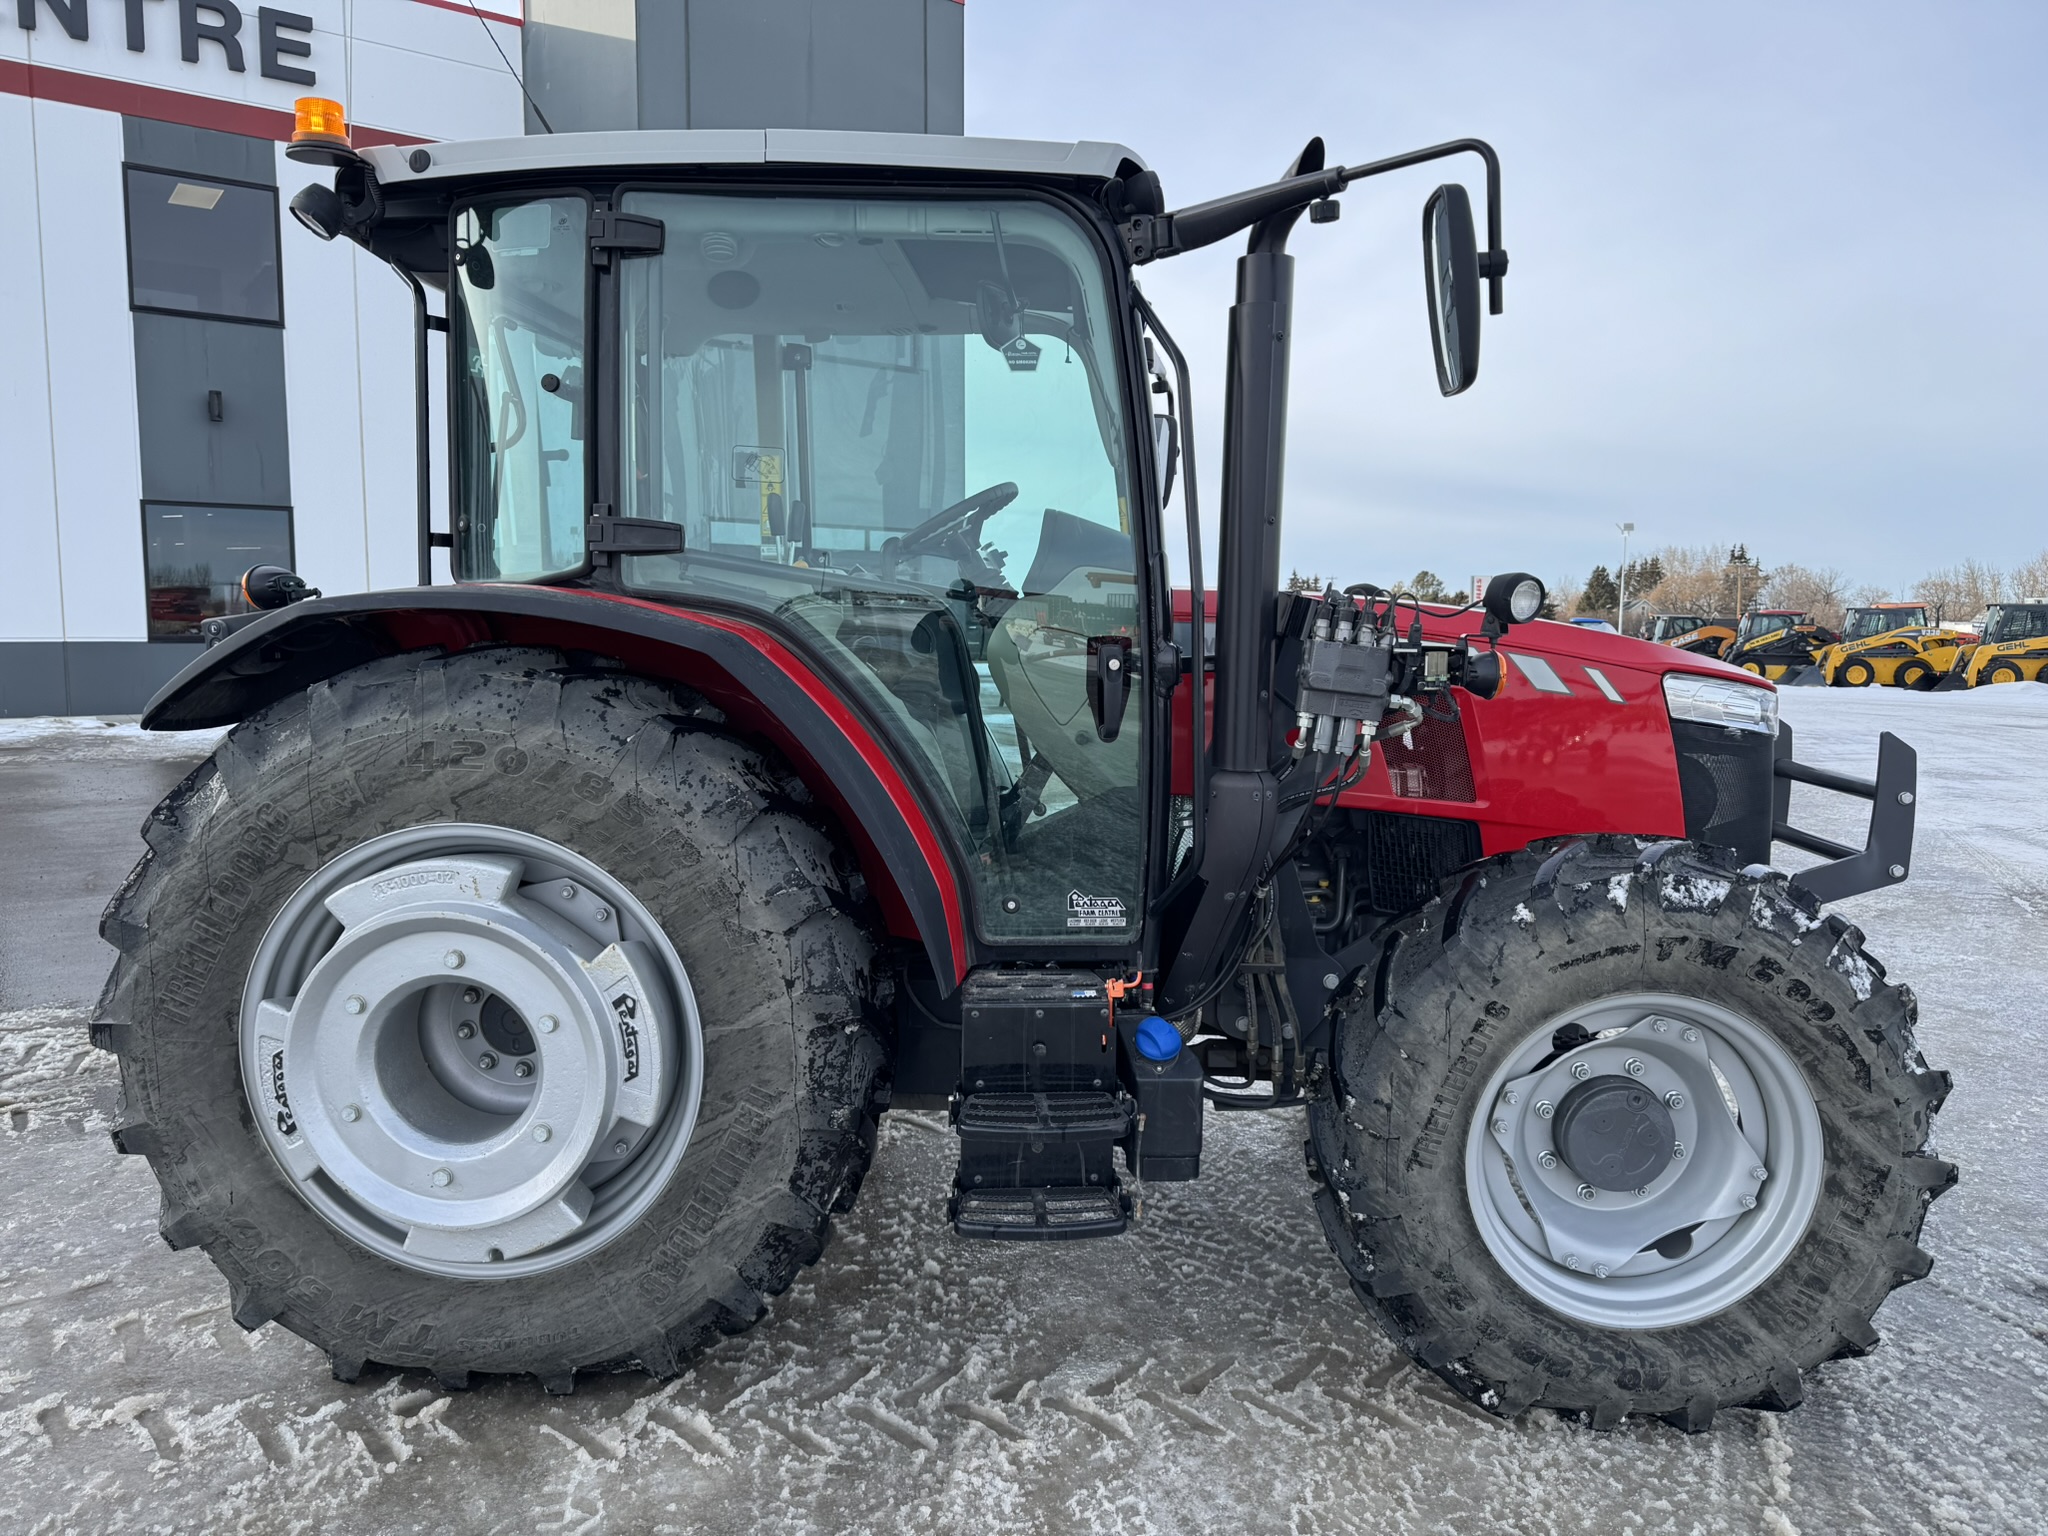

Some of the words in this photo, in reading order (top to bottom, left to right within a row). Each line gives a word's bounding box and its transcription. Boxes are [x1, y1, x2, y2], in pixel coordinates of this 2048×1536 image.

[1670, 632, 1699, 648] CASE
[1840, 640, 1871, 653] GEHL
[1996, 641, 2031, 652] GEHL
[1068, 889, 1126, 910] Pentagon
[152, 801, 289, 1025] TRELLEBORG
[1656, 936, 1744, 971] TM
[1745, 955, 1836, 1022] 600
[1404, 1000, 1511, 1173] TRELLEBORG
